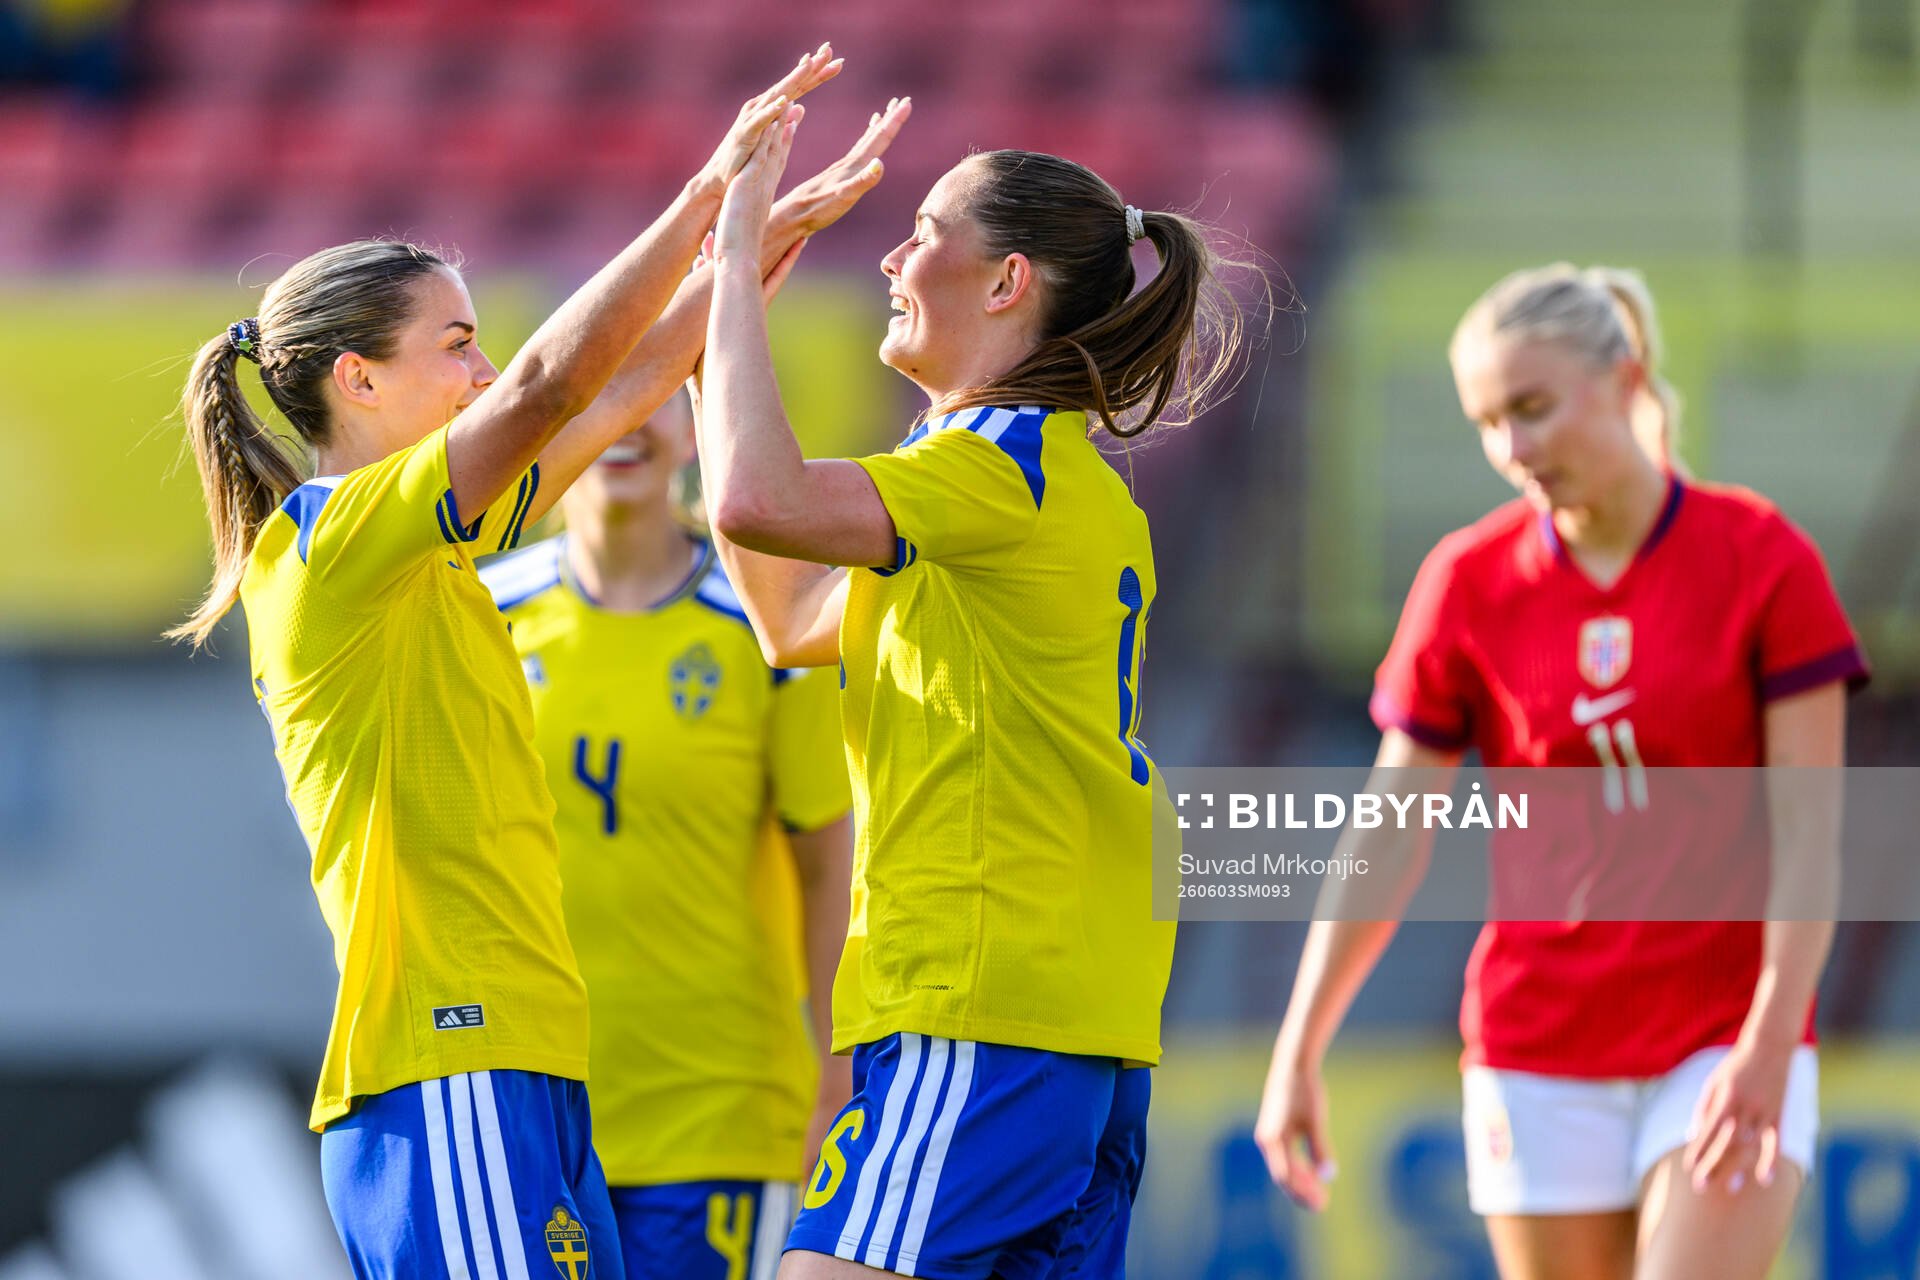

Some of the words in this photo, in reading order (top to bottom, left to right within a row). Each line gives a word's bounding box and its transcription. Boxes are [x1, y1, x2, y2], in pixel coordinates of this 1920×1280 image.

[573, 735, 621, 834] 4
[1586, 717, 1650, 815] 11
[705, 1191, 755, 1280] 4
